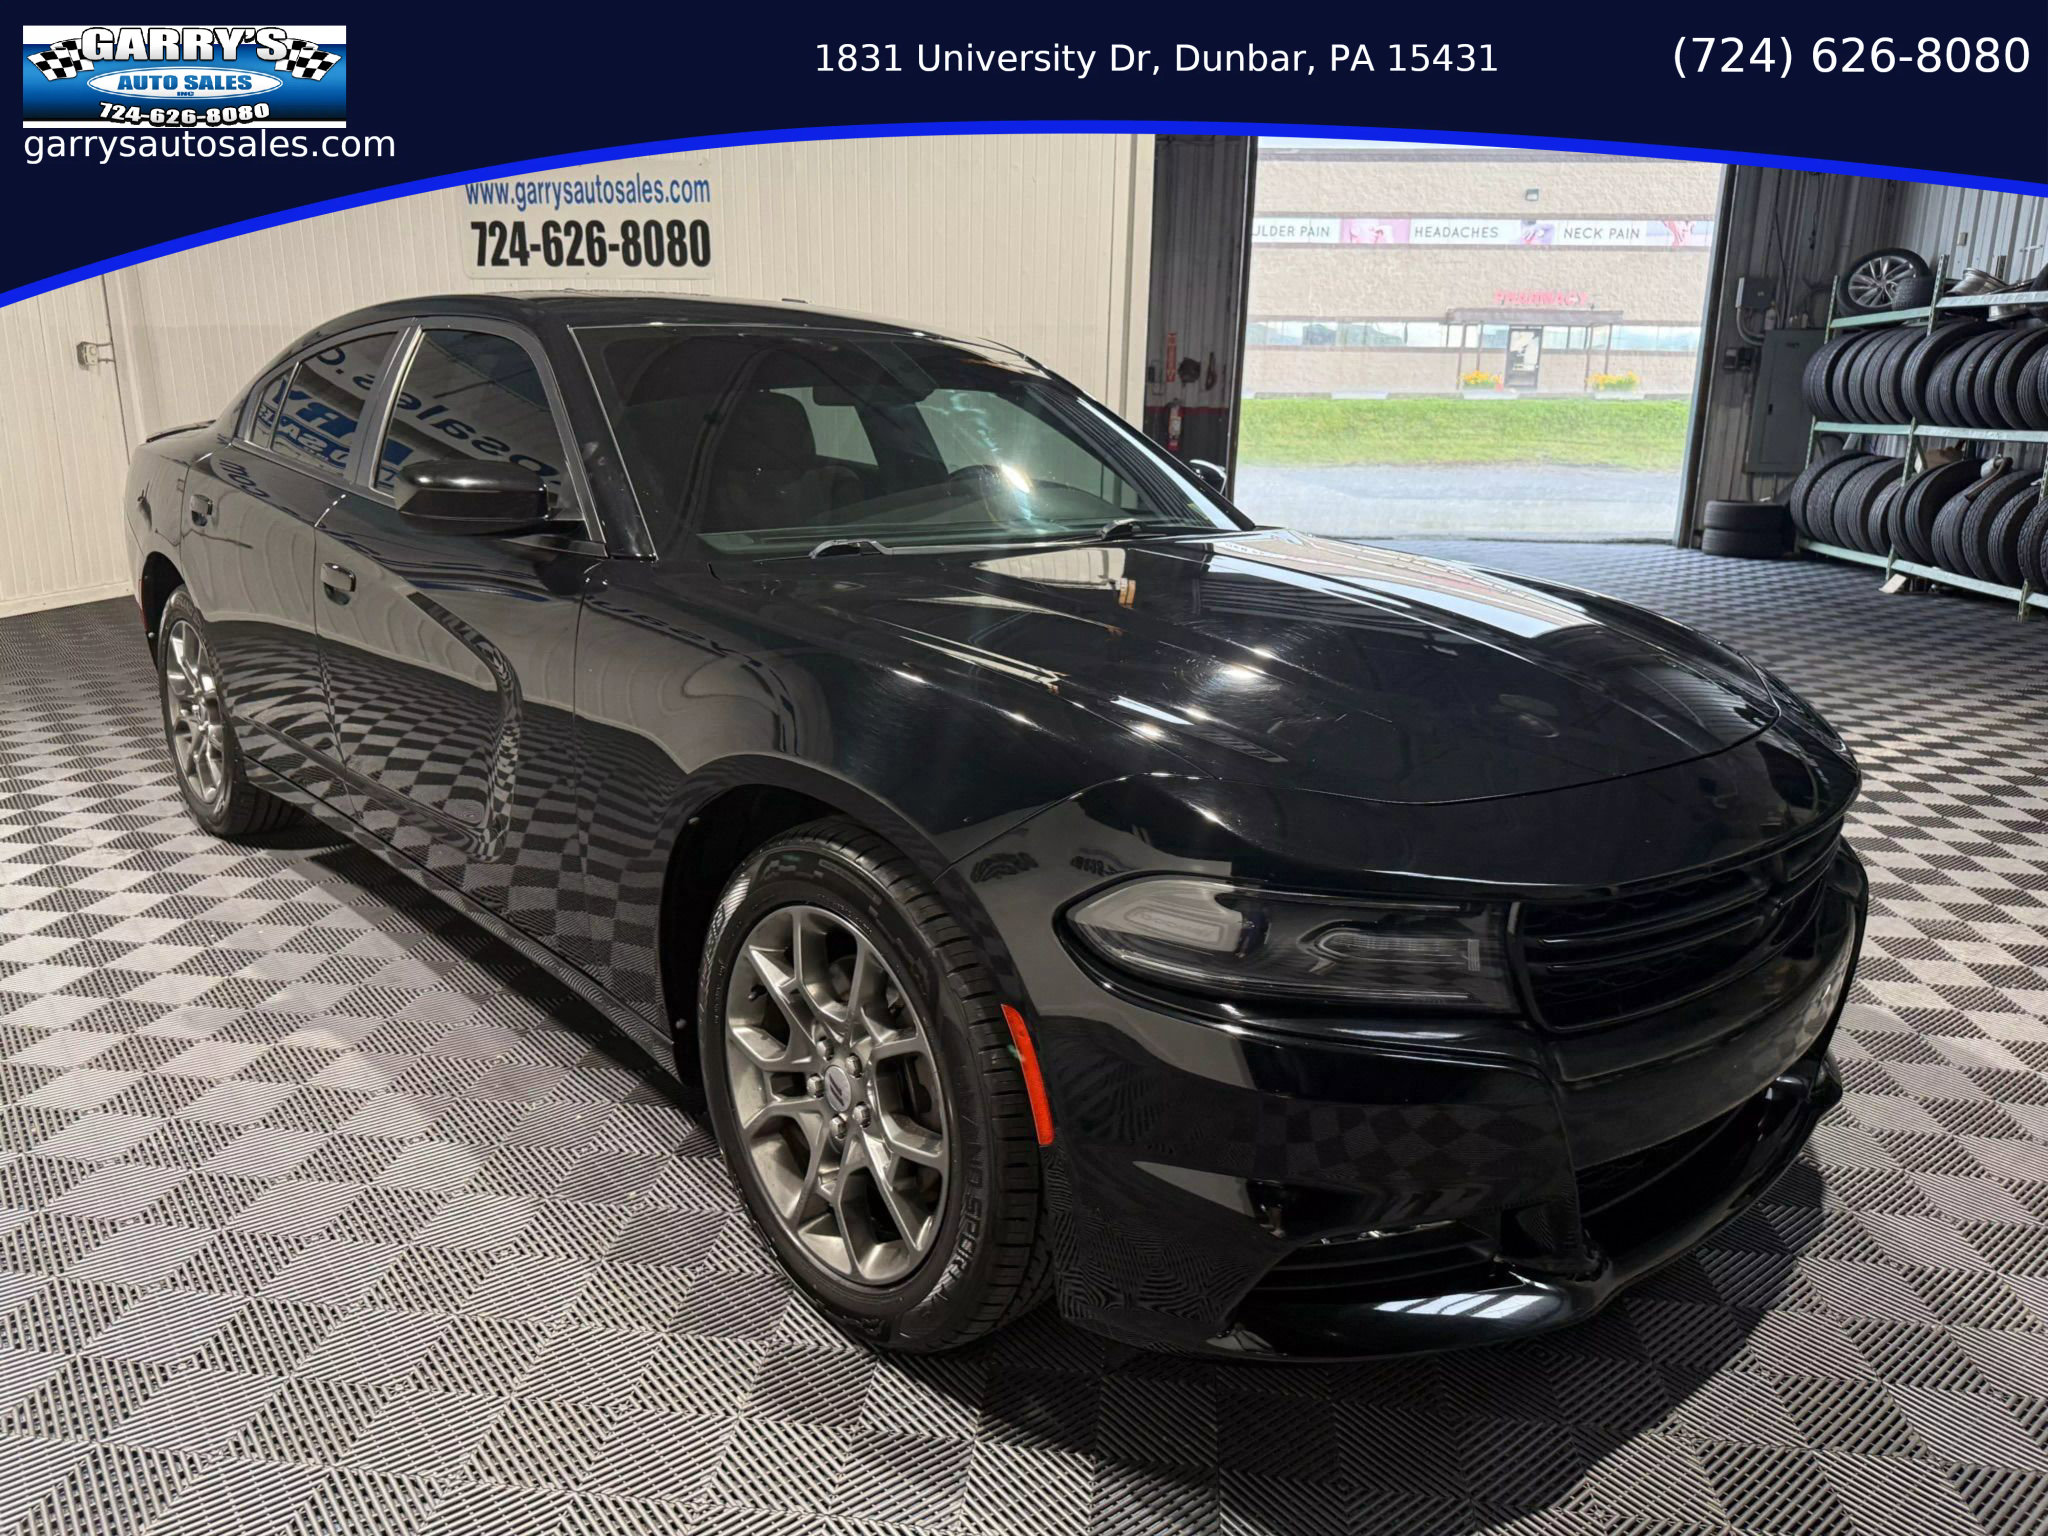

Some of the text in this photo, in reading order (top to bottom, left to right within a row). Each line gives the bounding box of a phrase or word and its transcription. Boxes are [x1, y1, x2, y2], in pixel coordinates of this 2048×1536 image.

[465, 172, 711, 212] www.garrysautosales.com
[1300, 226, 1331, 237] PAIN
[1414, 226, 1499, 238] HEADACHES
[1563, 227, 1641, 240] NECK PAIN
[471, 219, 711, 267] 724-626-8080
